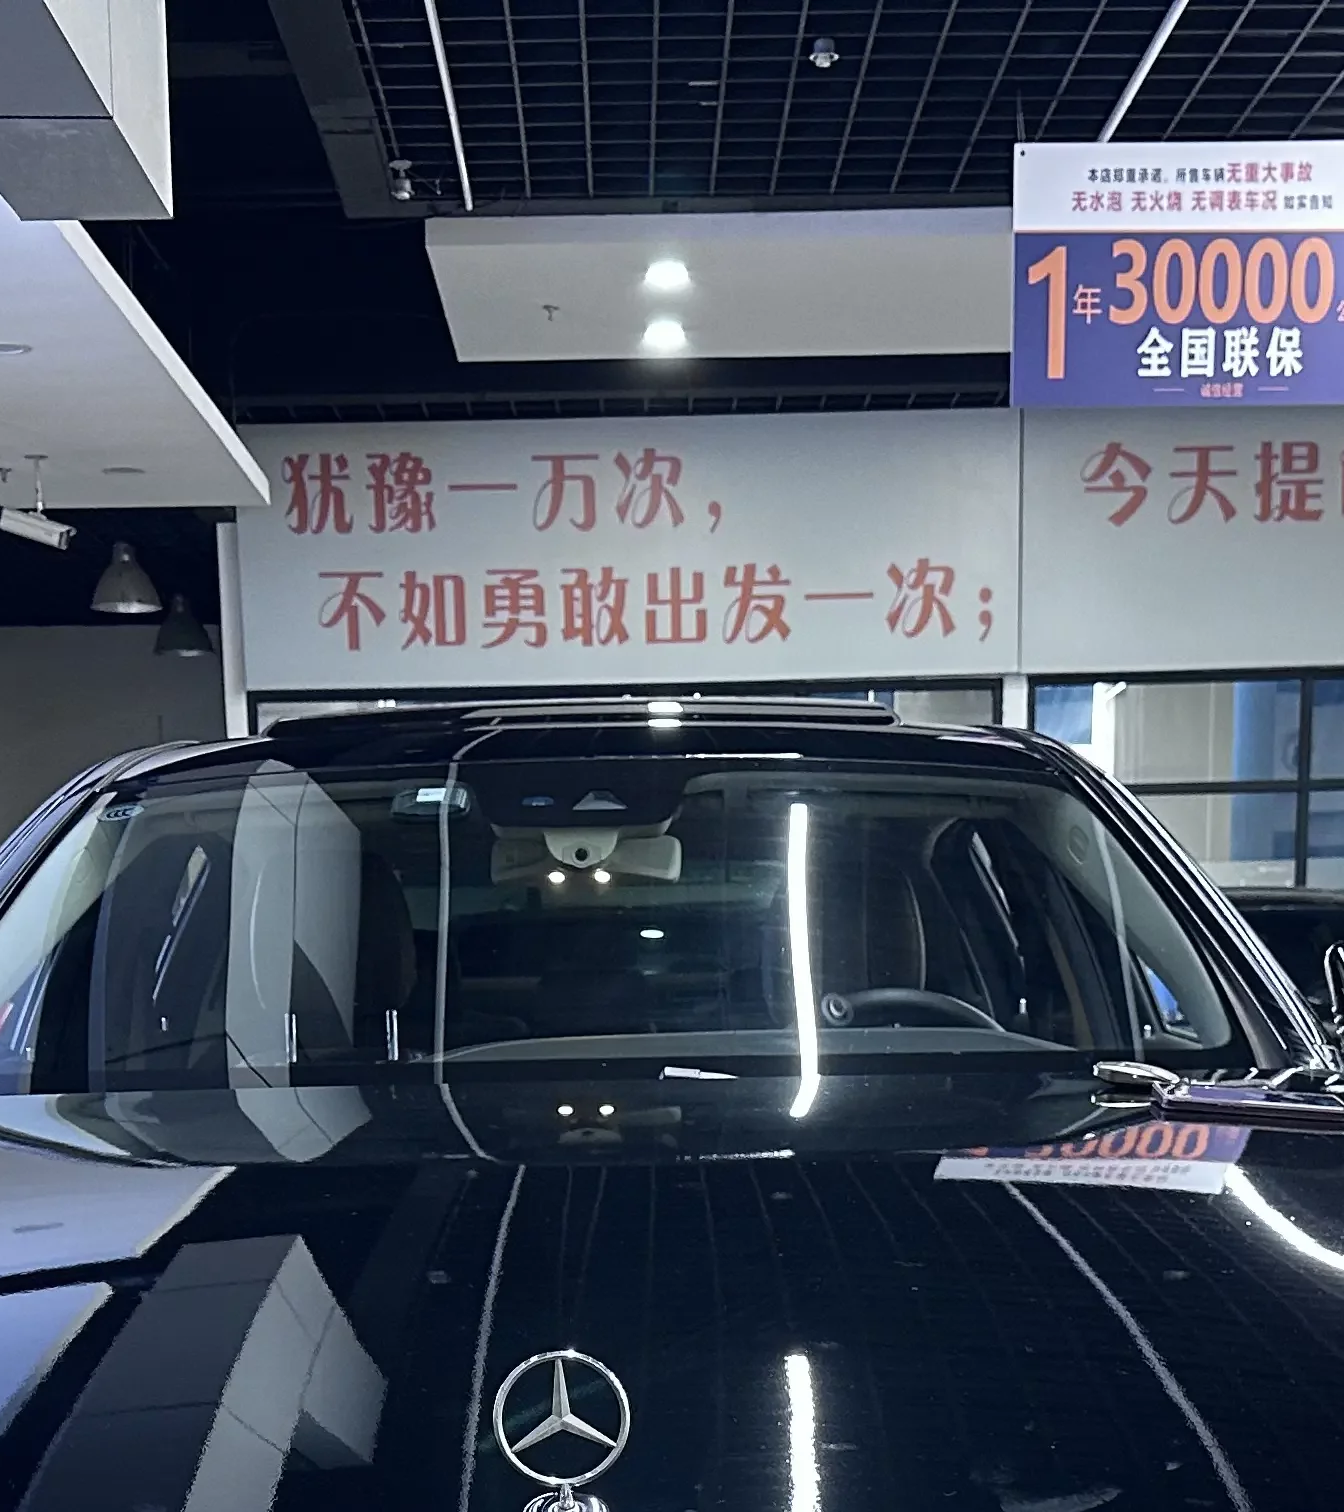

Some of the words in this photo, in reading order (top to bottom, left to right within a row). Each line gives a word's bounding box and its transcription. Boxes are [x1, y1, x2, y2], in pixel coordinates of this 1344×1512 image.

[1136, 326, 1304, 378] 全国联保
[280, 447, 724, 535] 犹豫一万次，
[318, 557, 995, 652] 不如勇敢出发一次；
